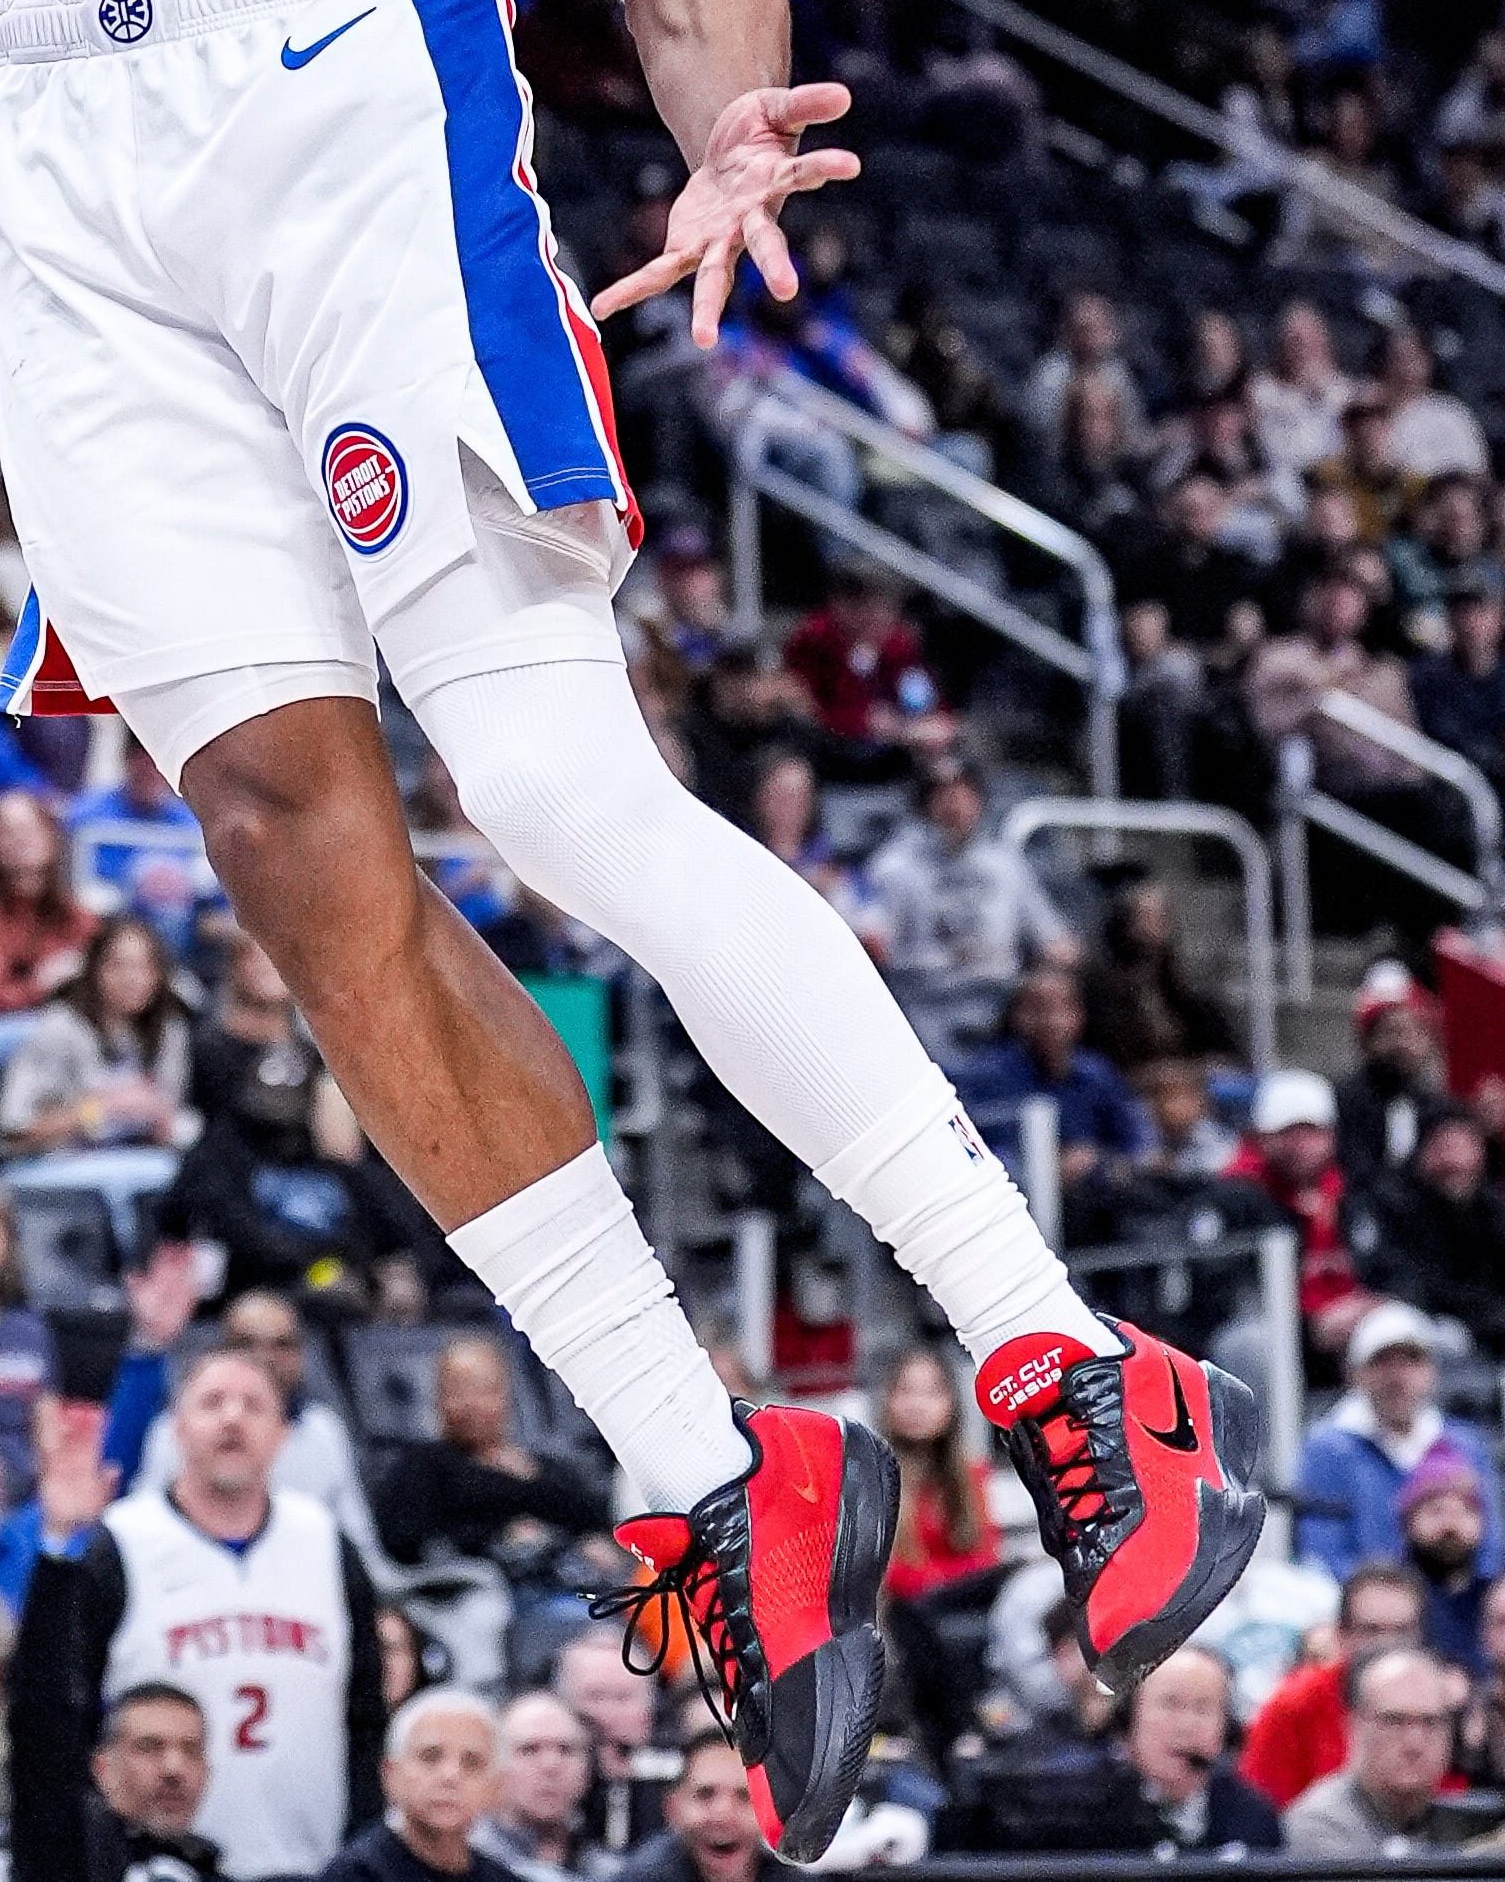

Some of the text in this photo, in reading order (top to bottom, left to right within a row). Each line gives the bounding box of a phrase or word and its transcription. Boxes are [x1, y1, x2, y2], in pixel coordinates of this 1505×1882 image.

[334, 454, 382, 502] DETROIT
[341, 473, 391, 522] PISTONS
[1019, 1347, 1063, 1382] CUT
[1007, 1367, 1063, 1411] JESUS
[234, 1684, 270, 1751] 2
